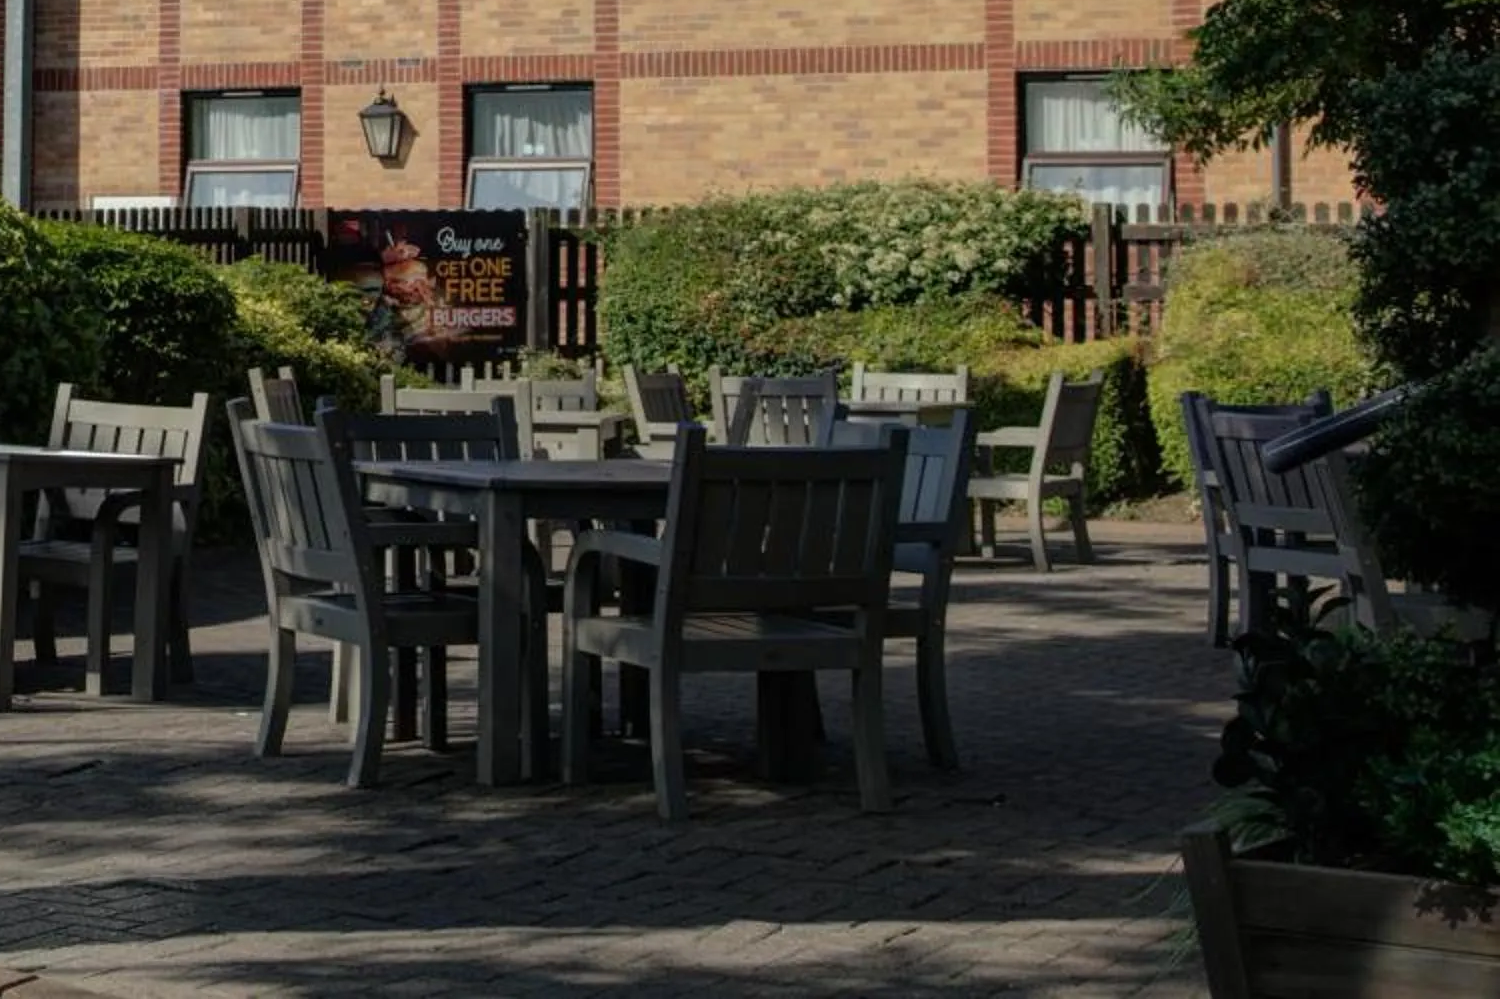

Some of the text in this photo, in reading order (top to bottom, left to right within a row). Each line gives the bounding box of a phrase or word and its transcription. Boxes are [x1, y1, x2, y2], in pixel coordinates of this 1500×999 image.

[437, 226, 504, 257] Buy one
[436, 257, 512, 277] GET ONE
[445, 278, 505, 302] FREE
[433, 307, 515, 327] BURGERS
